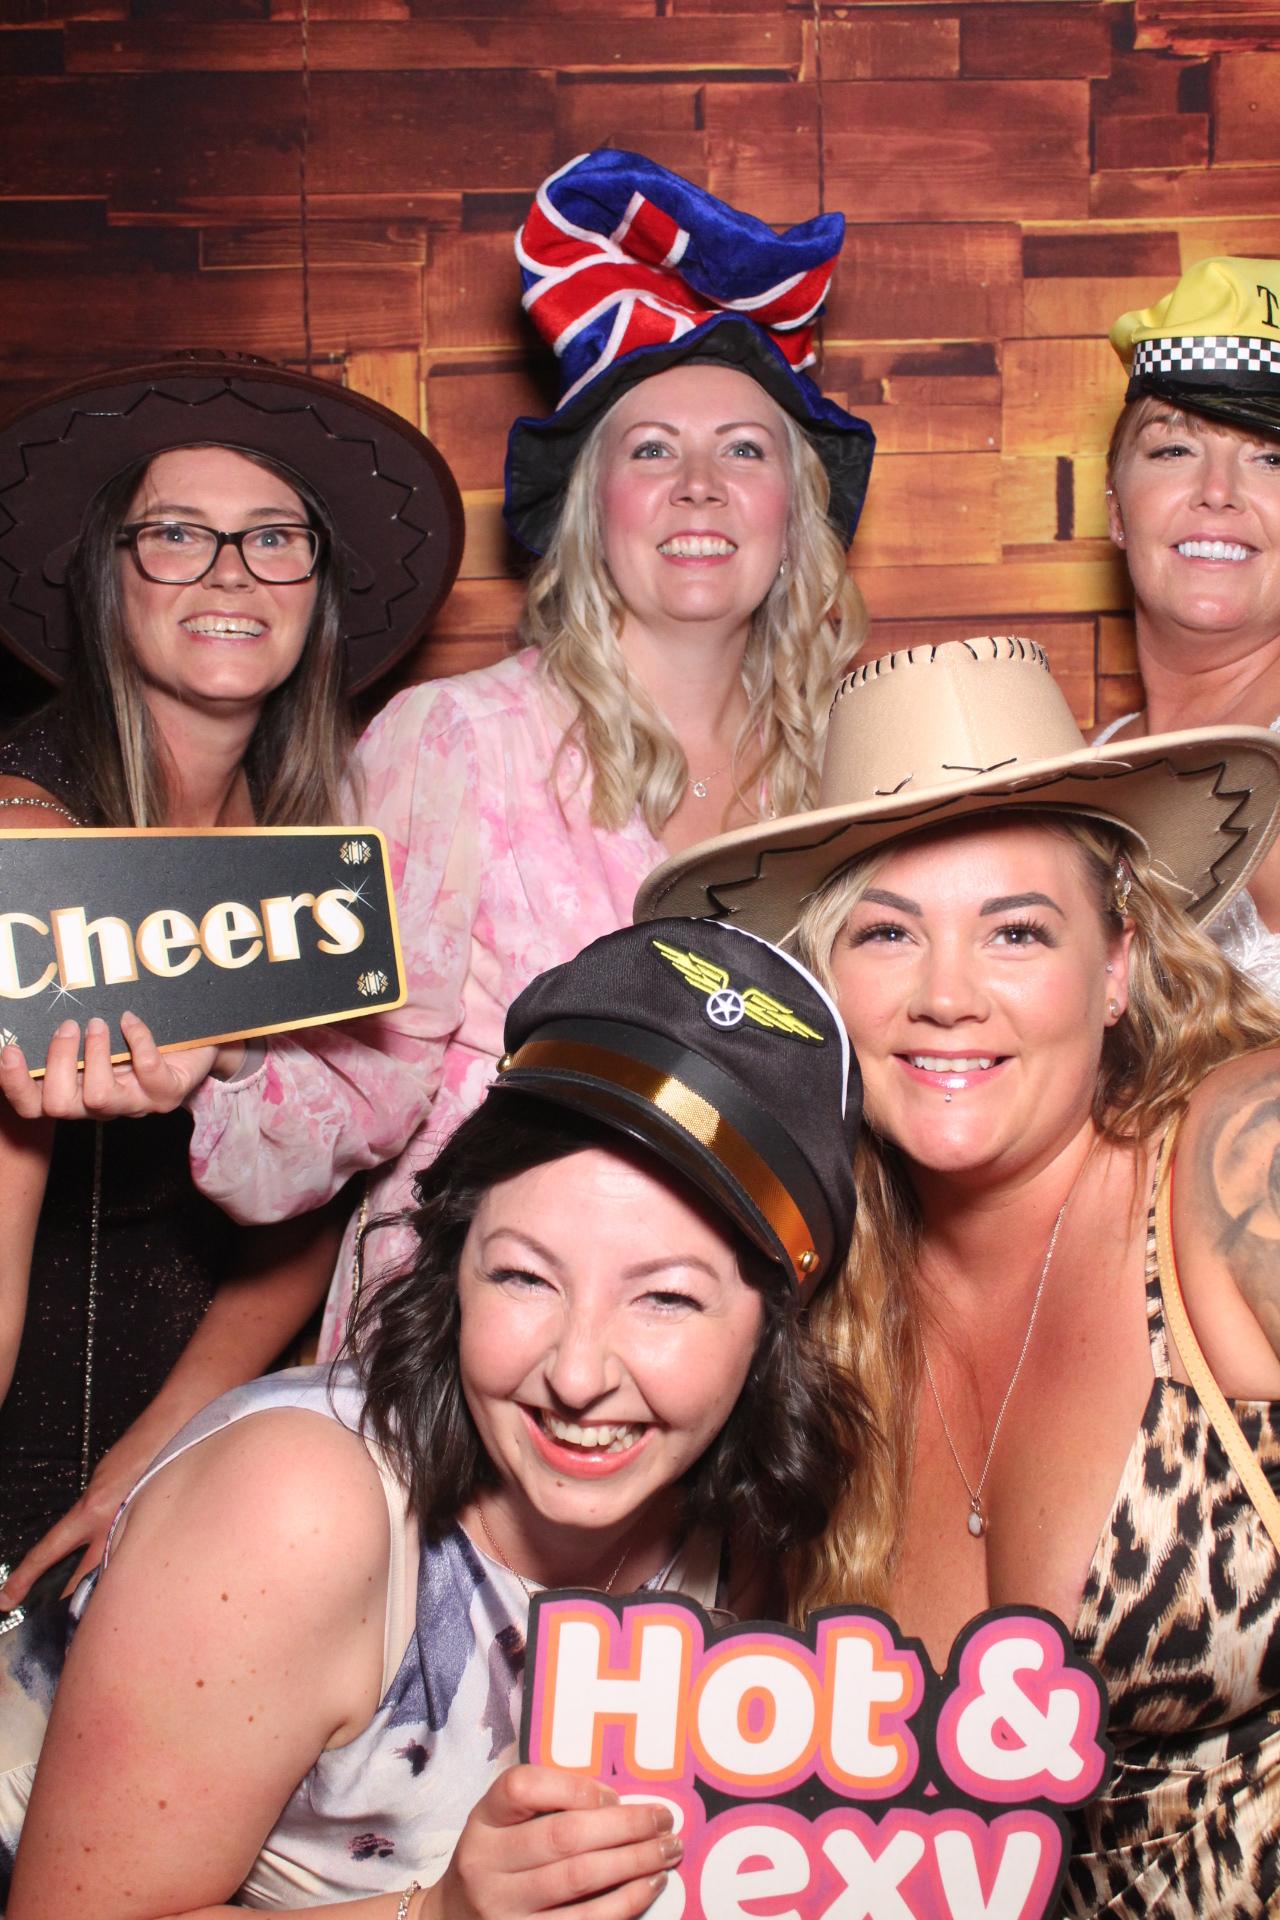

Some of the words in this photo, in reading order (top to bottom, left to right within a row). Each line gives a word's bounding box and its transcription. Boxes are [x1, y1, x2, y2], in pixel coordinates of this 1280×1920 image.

[0, 888, 365, 999] Cheers
[551, 1620, 904, 1779] Hot
[956, 1637, 1085, 1782] &
